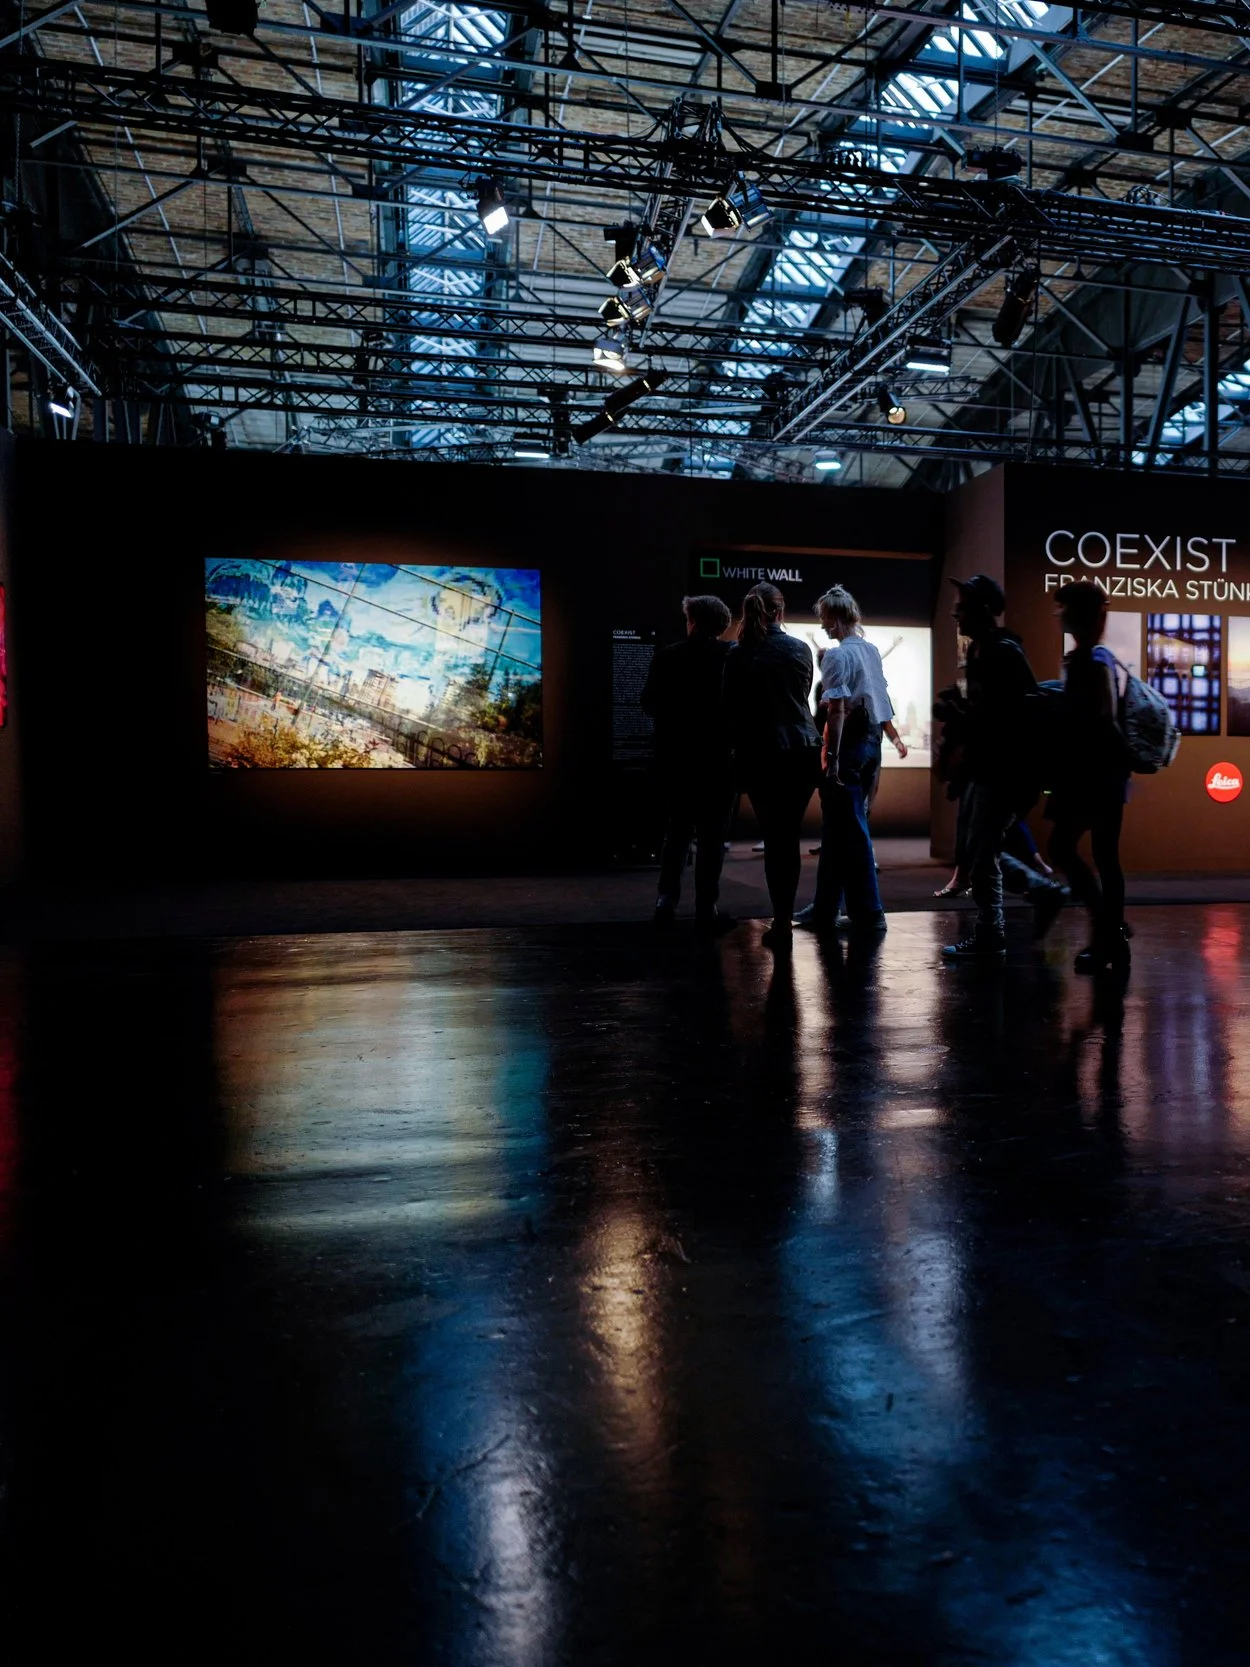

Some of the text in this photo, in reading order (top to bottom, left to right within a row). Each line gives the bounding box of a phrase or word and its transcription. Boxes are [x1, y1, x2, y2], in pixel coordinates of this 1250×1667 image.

[1045, 530, 1237, 573] COEXIST
[1045, 573, 1180, 598] FRNZISKA
[1207, 772, 1240, 790] Leica
